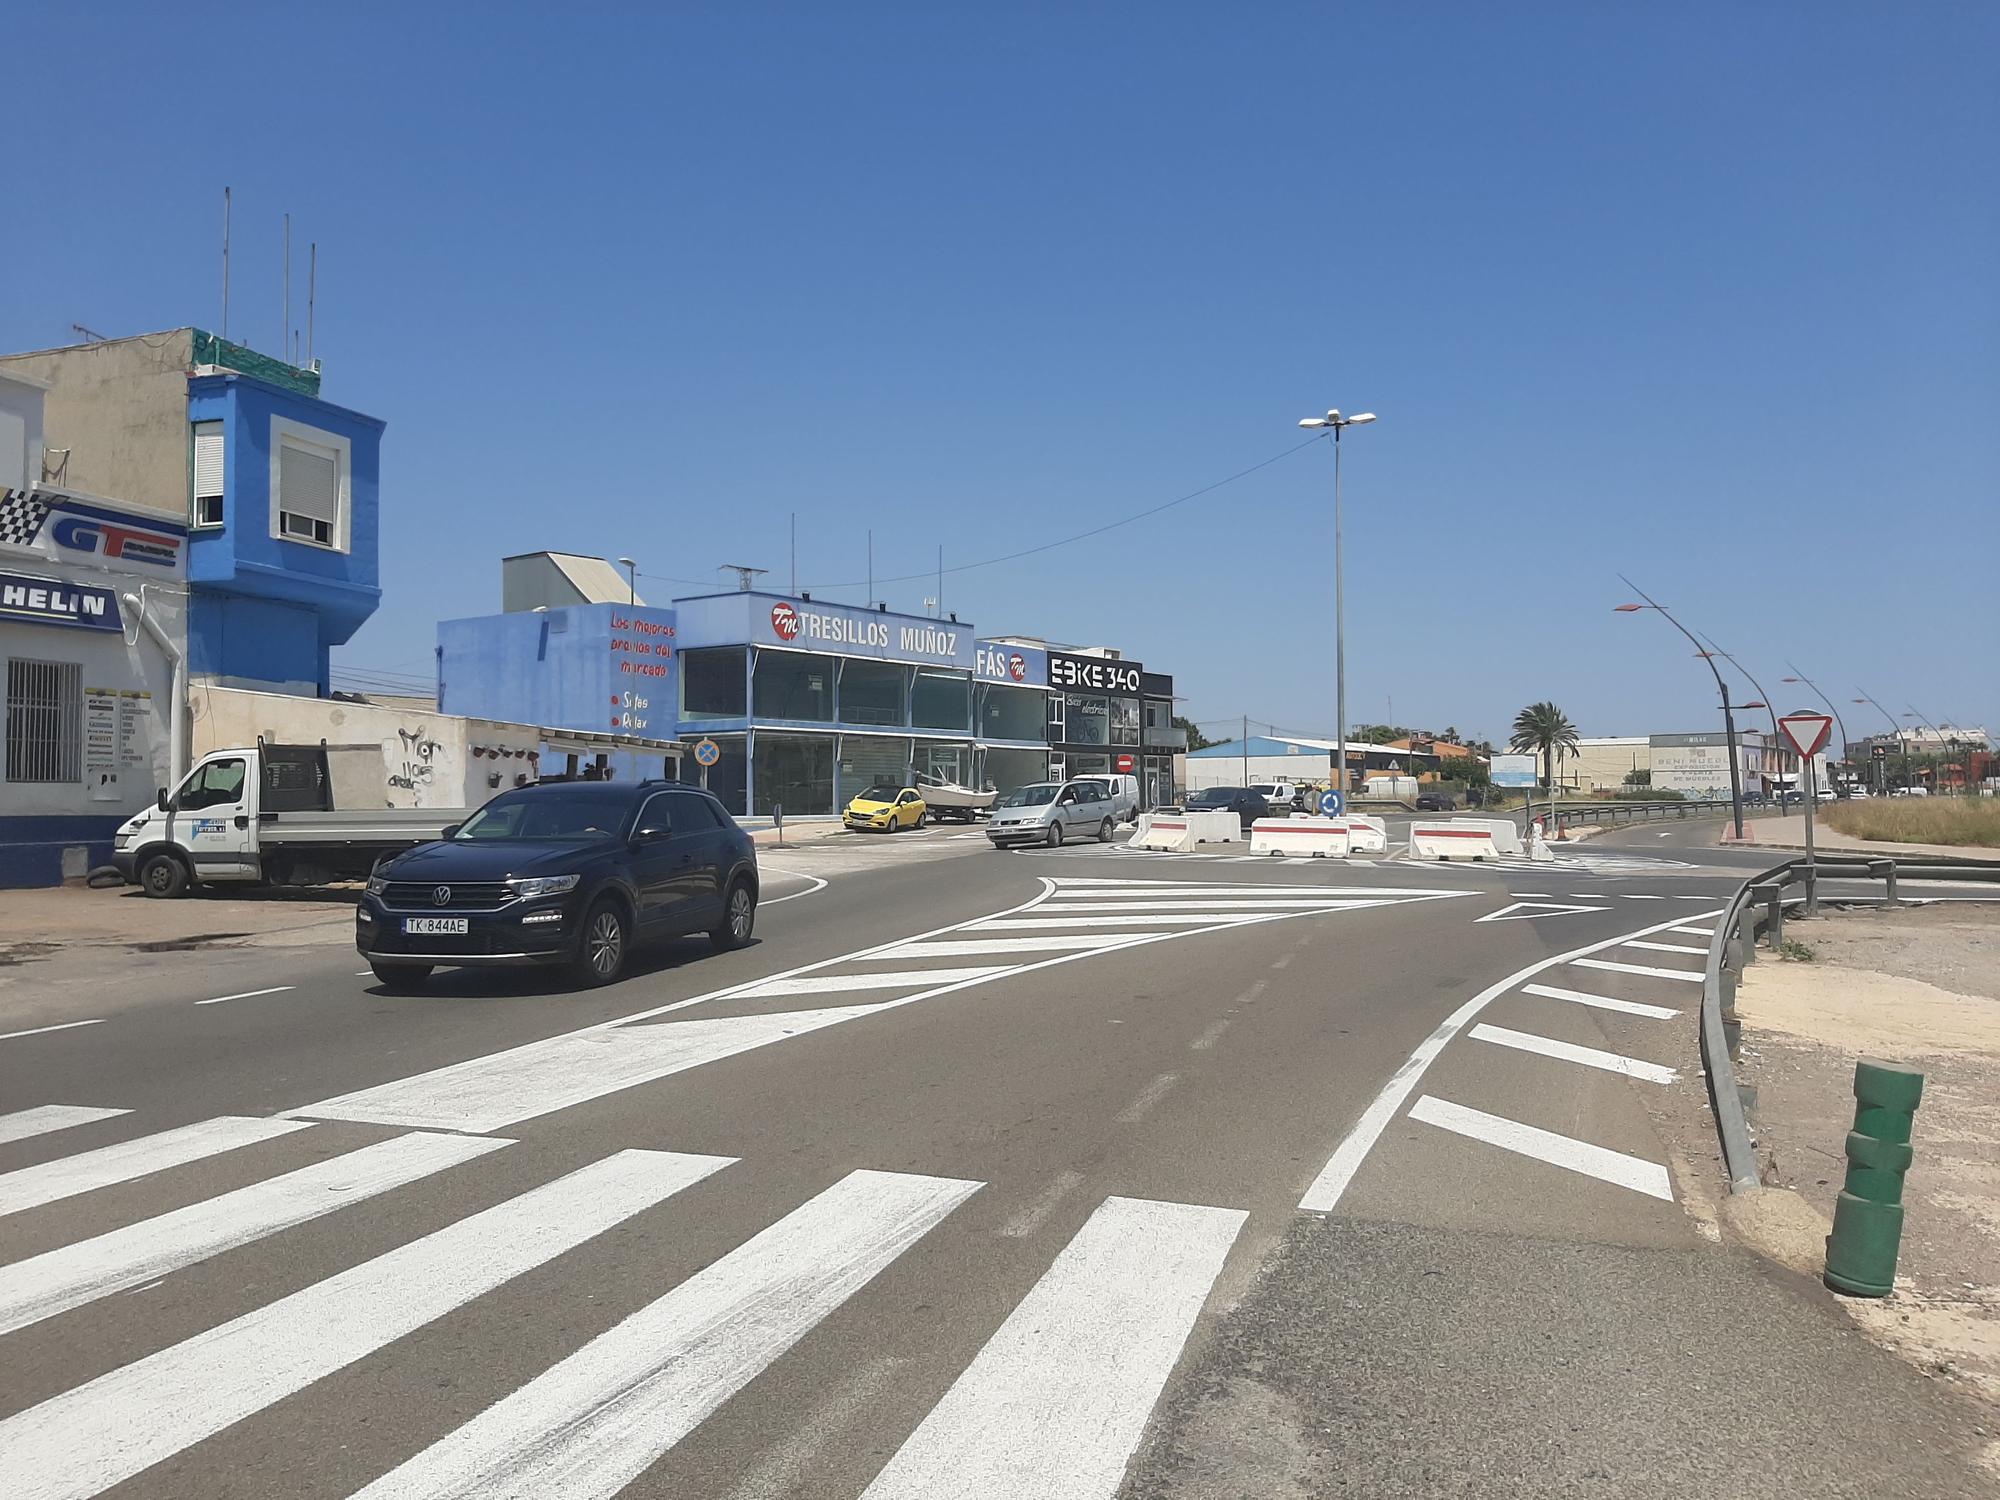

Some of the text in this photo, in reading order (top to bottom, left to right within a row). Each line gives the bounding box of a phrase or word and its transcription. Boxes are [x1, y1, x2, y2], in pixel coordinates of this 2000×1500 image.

[52, 518, 180, 558] GT
[3, 584, 105, 616] HELIN
[611, 638, 651, 654] preios
[798, 612, 957, 656] TRESILLOS MUÑOZ
[974, 645, 1006, 678] FÁS
[1106, 666, 1140, 692] 340
[1688, 757, 1729, 765] MUEBL
[408, 919, 465, 932] TK 844AE
